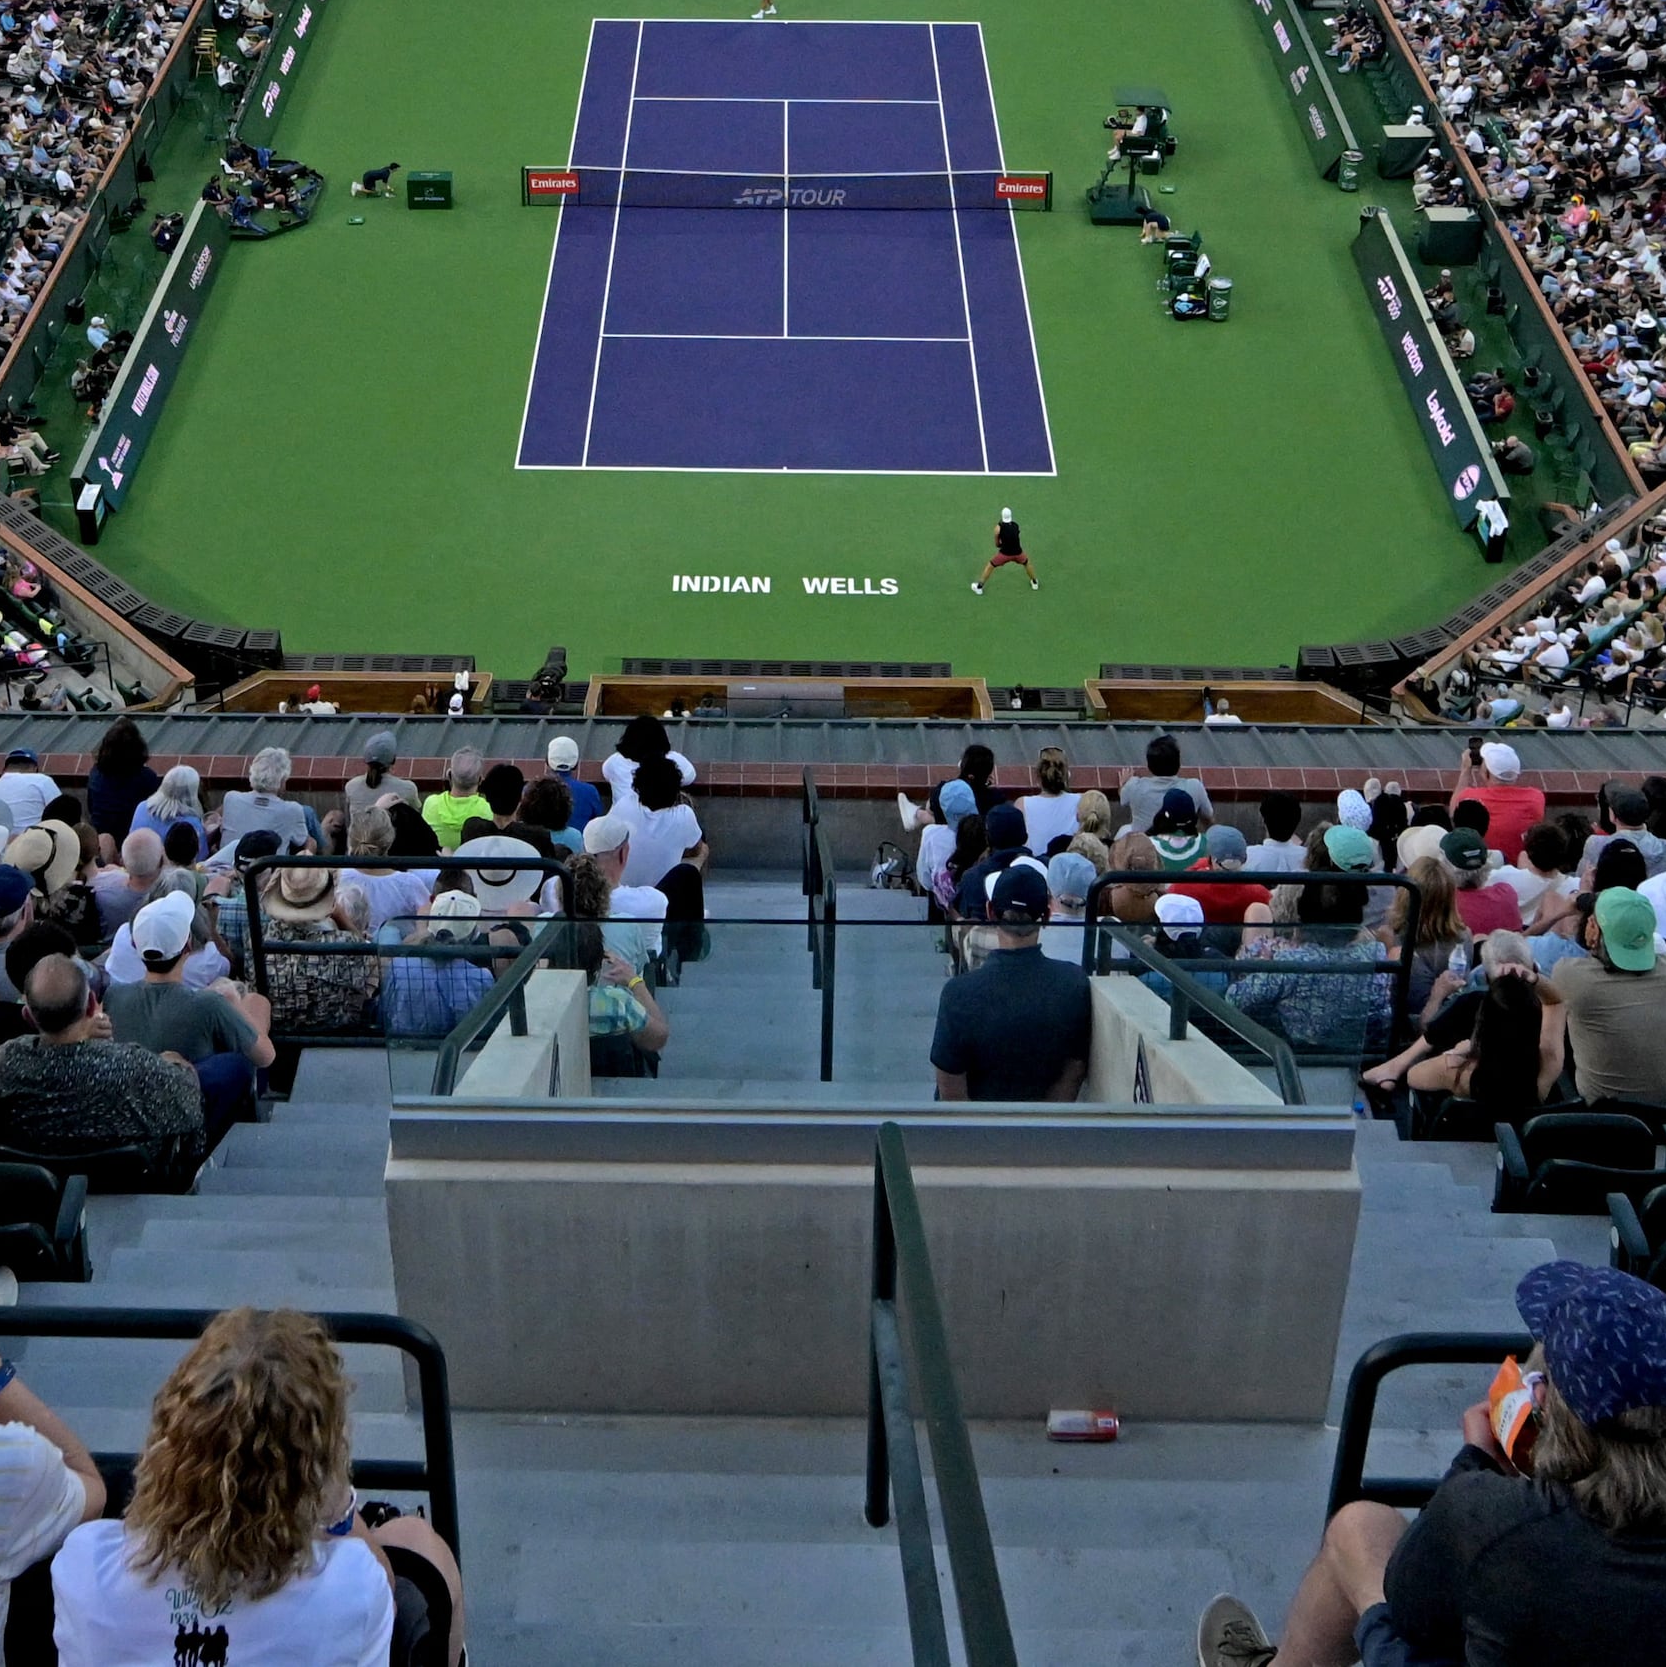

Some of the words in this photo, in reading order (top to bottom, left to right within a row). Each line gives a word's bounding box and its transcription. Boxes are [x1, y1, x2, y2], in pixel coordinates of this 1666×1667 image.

[531, 178, 576, 189] Emirates
[998, 182, 1044, 194] Emirates
[733, 188, 783, 205] ATP
[790, 188, 847, 205] TOUR
[1377, 275, 1396, 301] ATP
[1400, 330, 1425, 377] verizon
[1426, 388, 1456, 448] Laykold
[672, 577, 771, 593] INDIAN
[803, 577, 899, 595] WELLS
